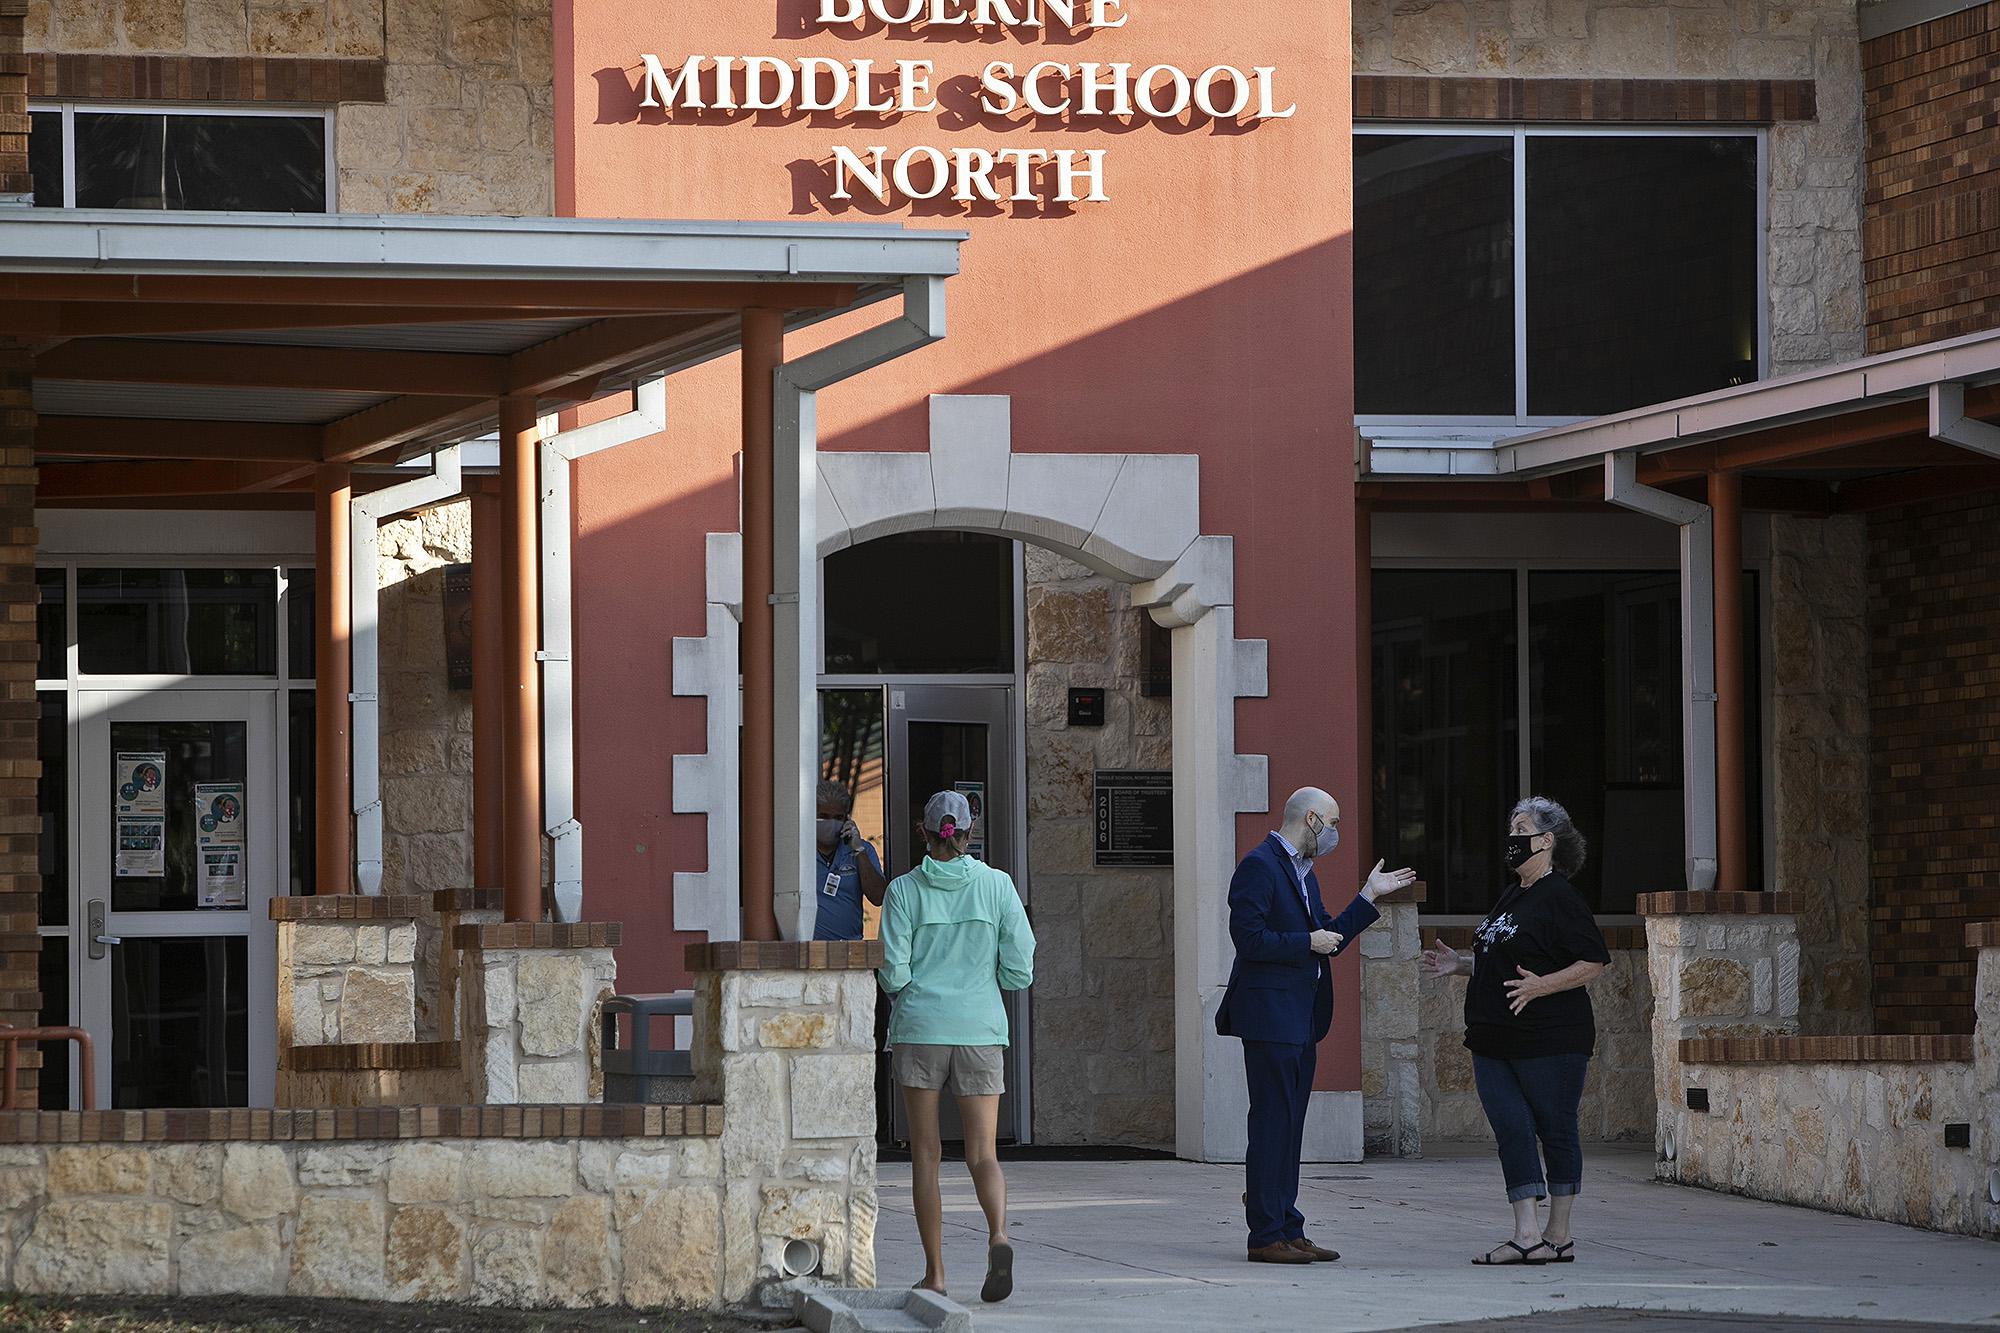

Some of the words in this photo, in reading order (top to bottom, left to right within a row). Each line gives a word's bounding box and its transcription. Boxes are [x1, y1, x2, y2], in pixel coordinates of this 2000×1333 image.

[640, 54, 937, 112] MIDDLE
[981, 61, 1297, 118] SCHOOL
[829, 145, 1111, 202] NORTH
